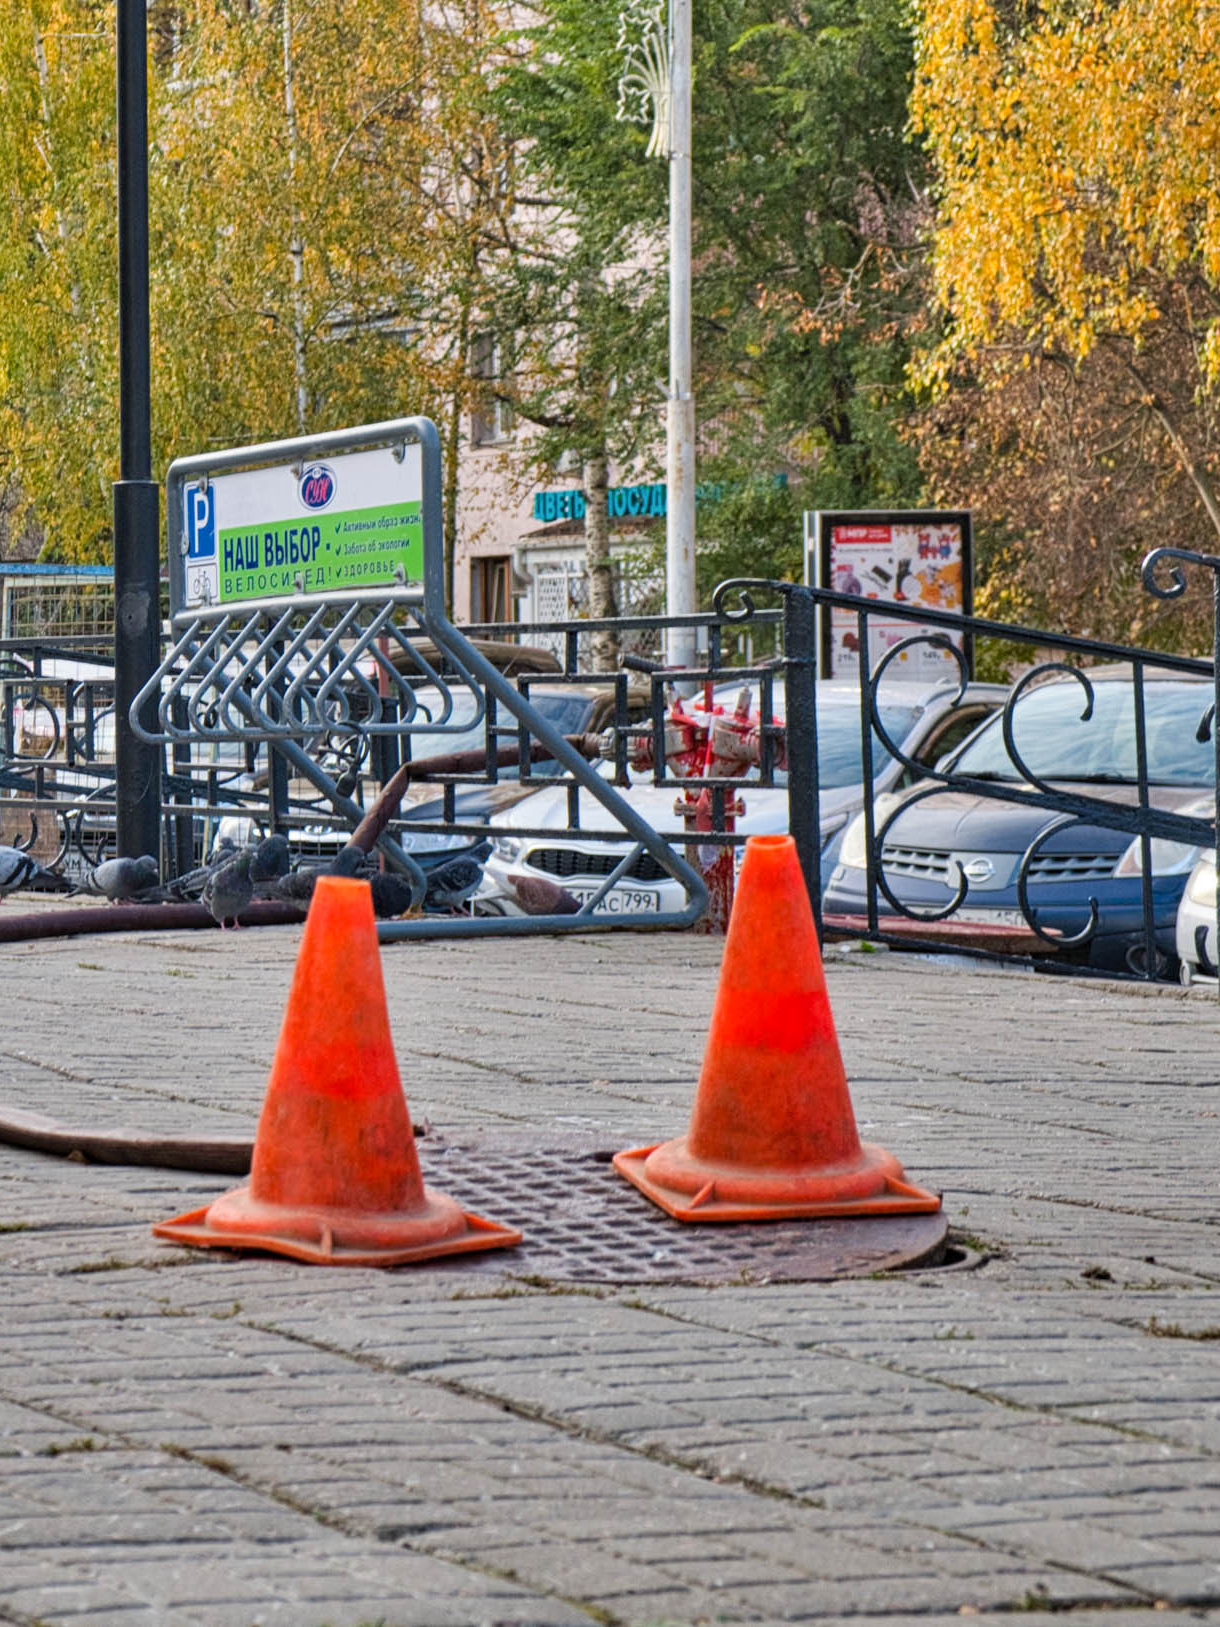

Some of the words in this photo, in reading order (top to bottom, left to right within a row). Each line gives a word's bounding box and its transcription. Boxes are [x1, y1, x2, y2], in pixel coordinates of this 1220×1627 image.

[193, 491, 210, 554] P
[223, 533, 260, 573] НАШ
[264, 525, 322, 569] ВЫБОР
[344, 559, 395, 578] ЗДОРОВЬЕ
[624, 892, 652, 909] 799
